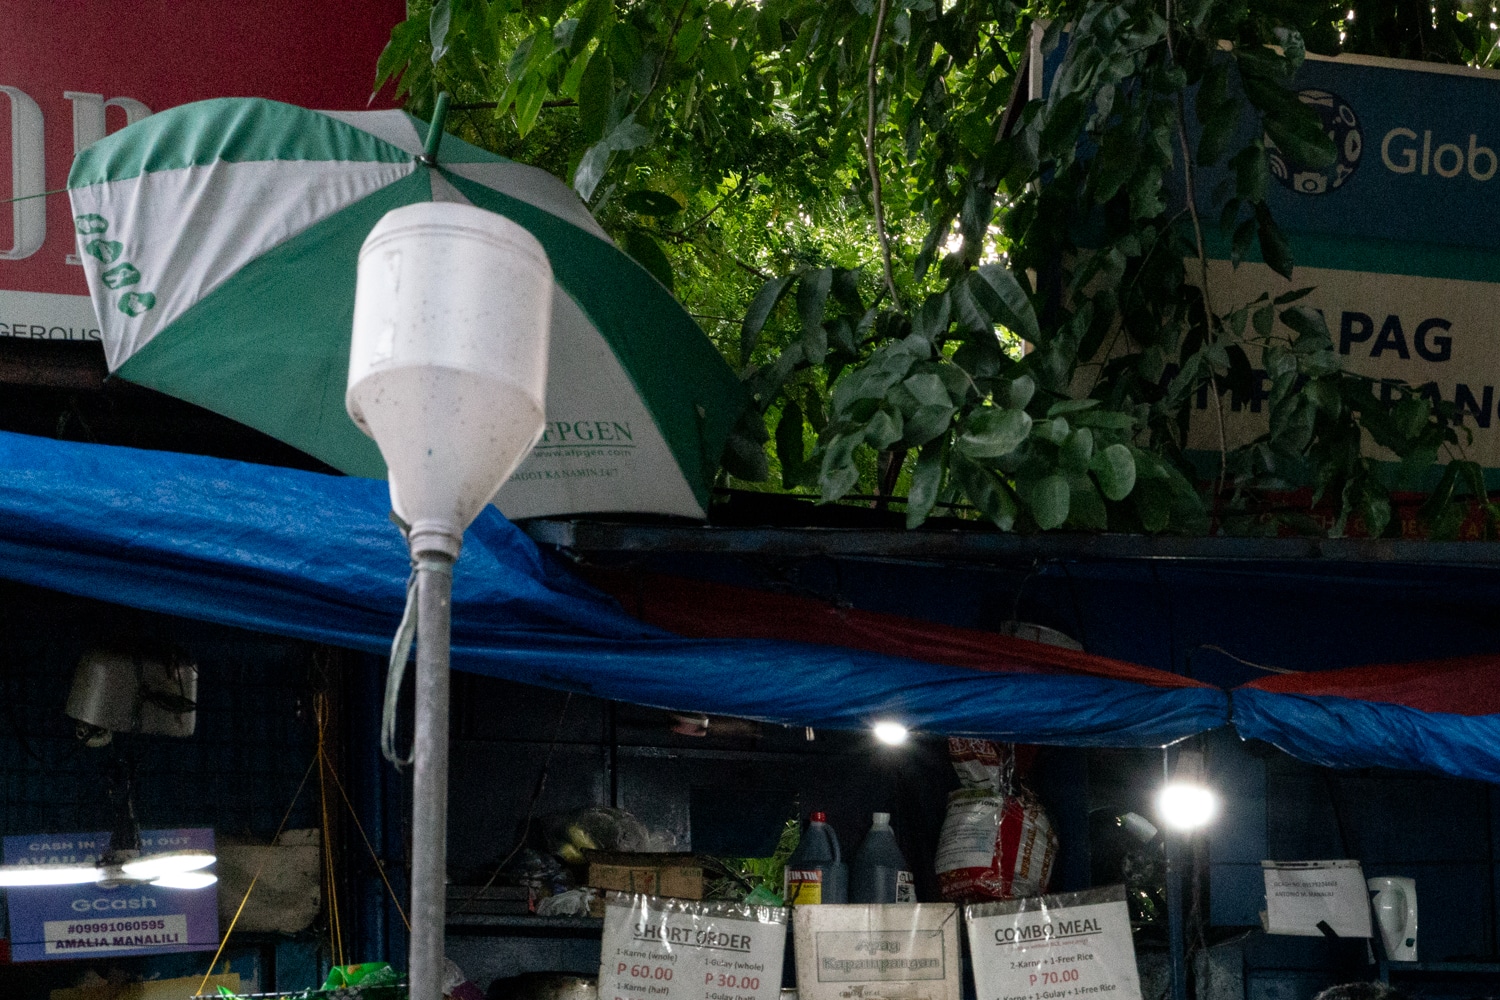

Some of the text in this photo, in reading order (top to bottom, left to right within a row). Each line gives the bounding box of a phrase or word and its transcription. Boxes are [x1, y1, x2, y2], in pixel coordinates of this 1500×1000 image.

[29, 842, 73, 852] CASH
[78, 841, 95, 850] IN
[70, 896, 157, 913] GCash
[67, 920, 165, 935] #09991060595
[994, 918, 1103, 943] COMBO MEAL
[55, 933, 180, 950] AMALIA MANALILI
[633, 923, 752, 950] SHORT ORDER
[734, 959, 765, 973] (whole)
[1050, 957, 1075, 966] 1-Free
[1076, 953, 1094, 962] Rice
[616, 962, 674, 981] P 60.00
[1029, 968, 1080, 987] P 70.00
[648, 984, 670, 996] (half)
[705, 972, 761, 991] P 30.00
[1035, 990, 1067, 1000] 1-Gulay
[1074, 986, 1099, 996] 1-Free
[1099, 983, 1117, 992] Rice
